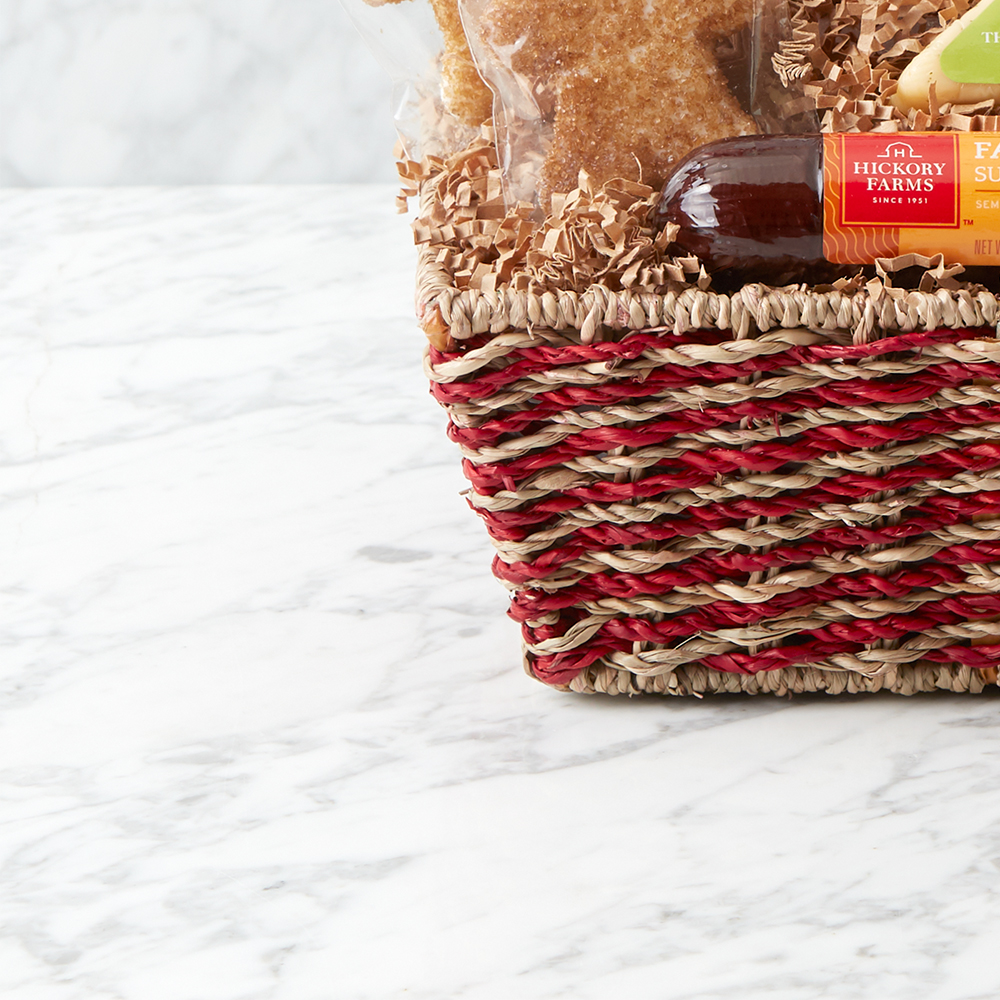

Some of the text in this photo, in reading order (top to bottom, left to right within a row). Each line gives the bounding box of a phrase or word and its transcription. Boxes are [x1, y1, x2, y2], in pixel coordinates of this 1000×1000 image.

[853, 162, 946, 175] HICKORY
[866, 177, 934, 192] FARMS
[974, 239, 993, 255] NET
